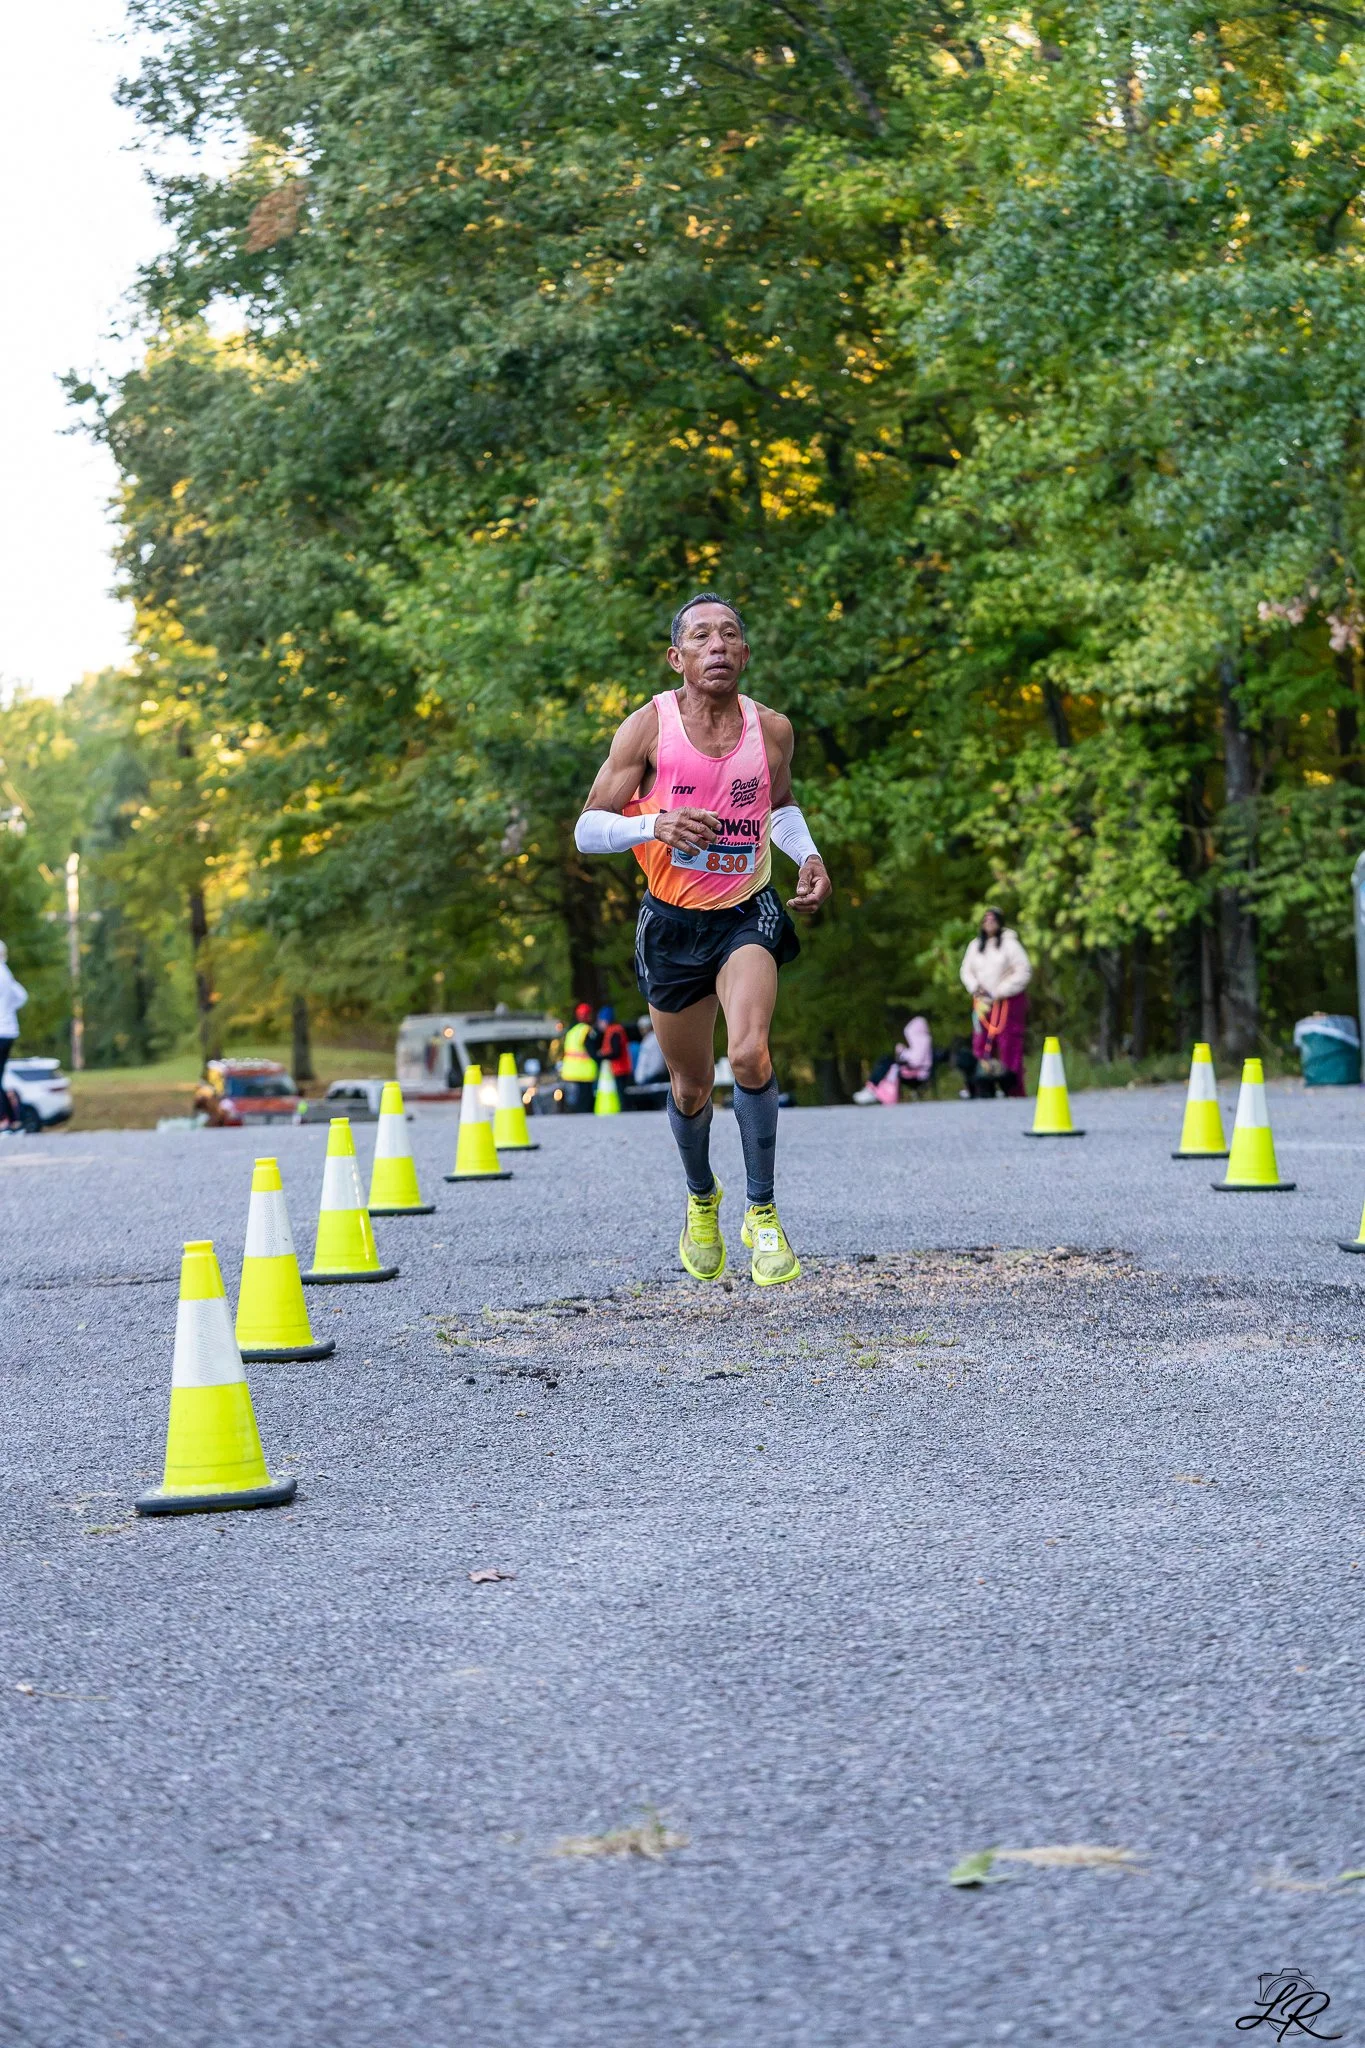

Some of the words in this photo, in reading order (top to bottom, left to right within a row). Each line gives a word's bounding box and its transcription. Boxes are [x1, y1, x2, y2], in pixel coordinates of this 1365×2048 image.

[730, 776, 760, 796] Party
[731, 791, 757, 808] Pace
[705, 853, 748, 873] 830
